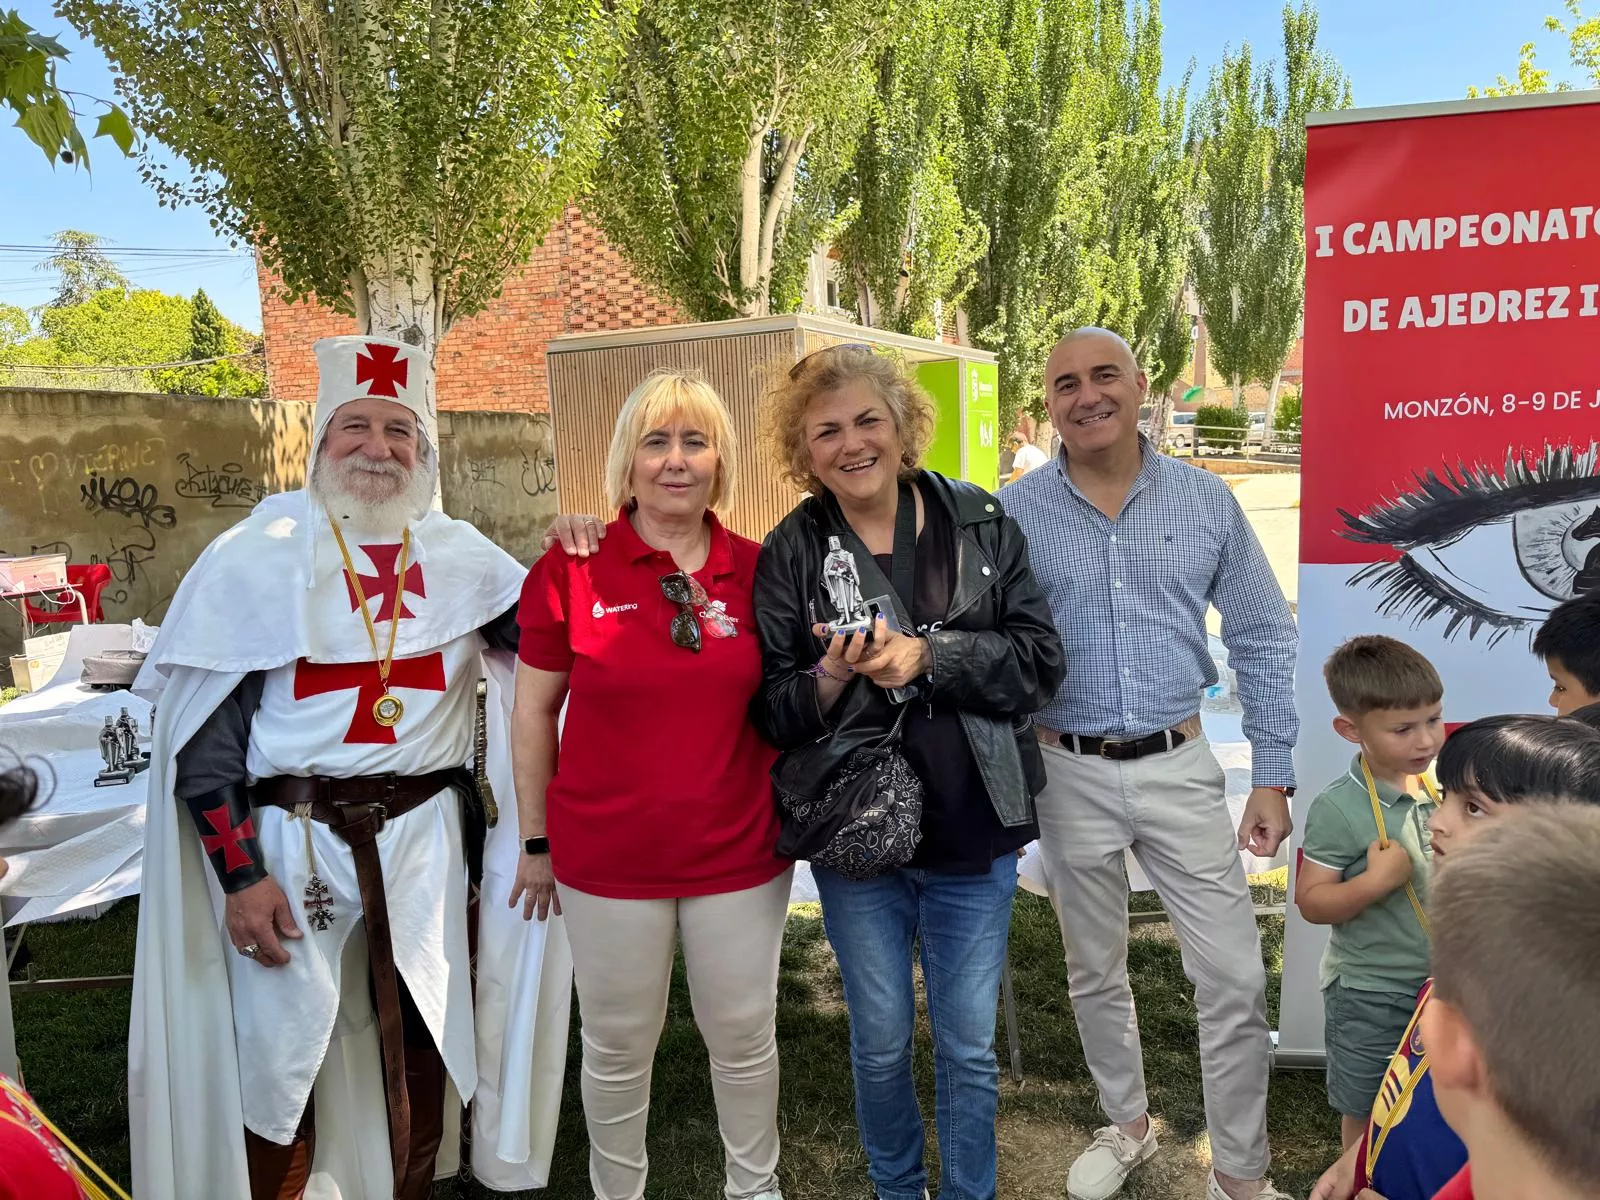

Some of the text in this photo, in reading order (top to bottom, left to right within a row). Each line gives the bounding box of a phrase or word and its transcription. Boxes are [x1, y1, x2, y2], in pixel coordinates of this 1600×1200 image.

[1314, 206, 1600, 258] I CAMPEONAT
[1343, 298, 1389, 333] DE
[1397, 286, 1571, 329] AJEDREZ
[1384, 392, 1495, 420] MONZÓN,
[1553, 390, 1582, 410] DE
